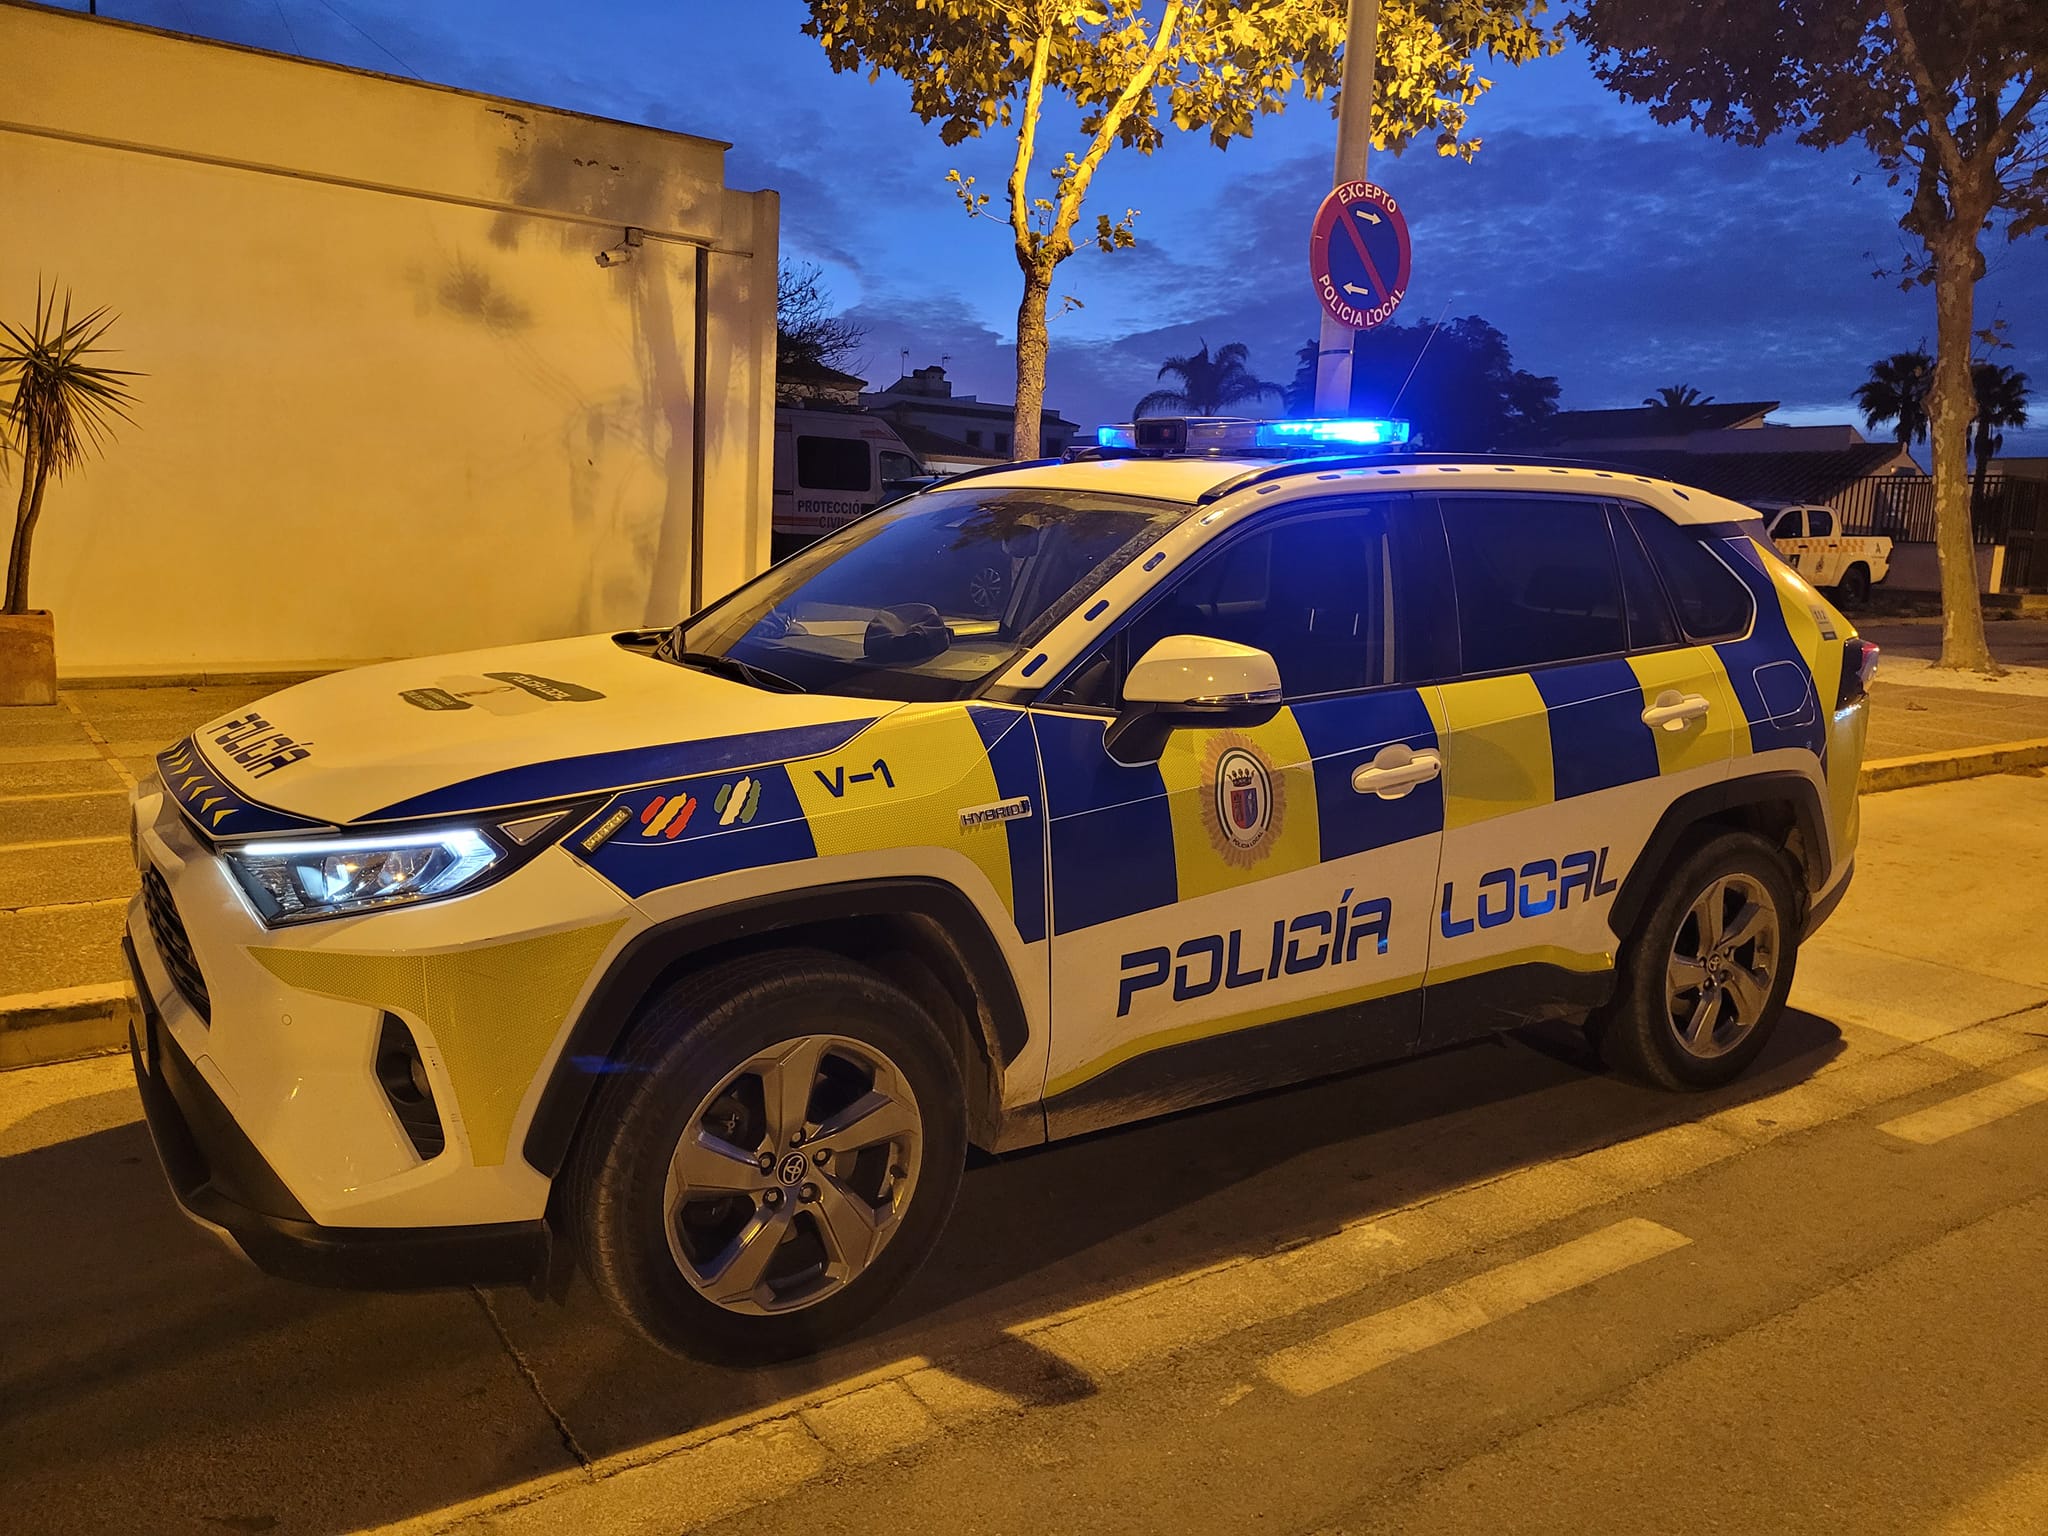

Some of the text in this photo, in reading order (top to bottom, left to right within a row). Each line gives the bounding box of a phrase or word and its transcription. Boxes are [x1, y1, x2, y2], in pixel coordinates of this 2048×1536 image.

[1338, 183, 1397, 213] EXCEPTO
[1319, 274, 1405, 326] POLICIA LOCAL
[798, 500, 863, 515] PROTECCIÓ
[206, 712, 314, 779] POLICÍA
[814, 758, 895, 798] V-1
[961, 803, 1021, 825] HYBRID
[1116, 847, 1619, 1018] POLICÍA LOCAL
